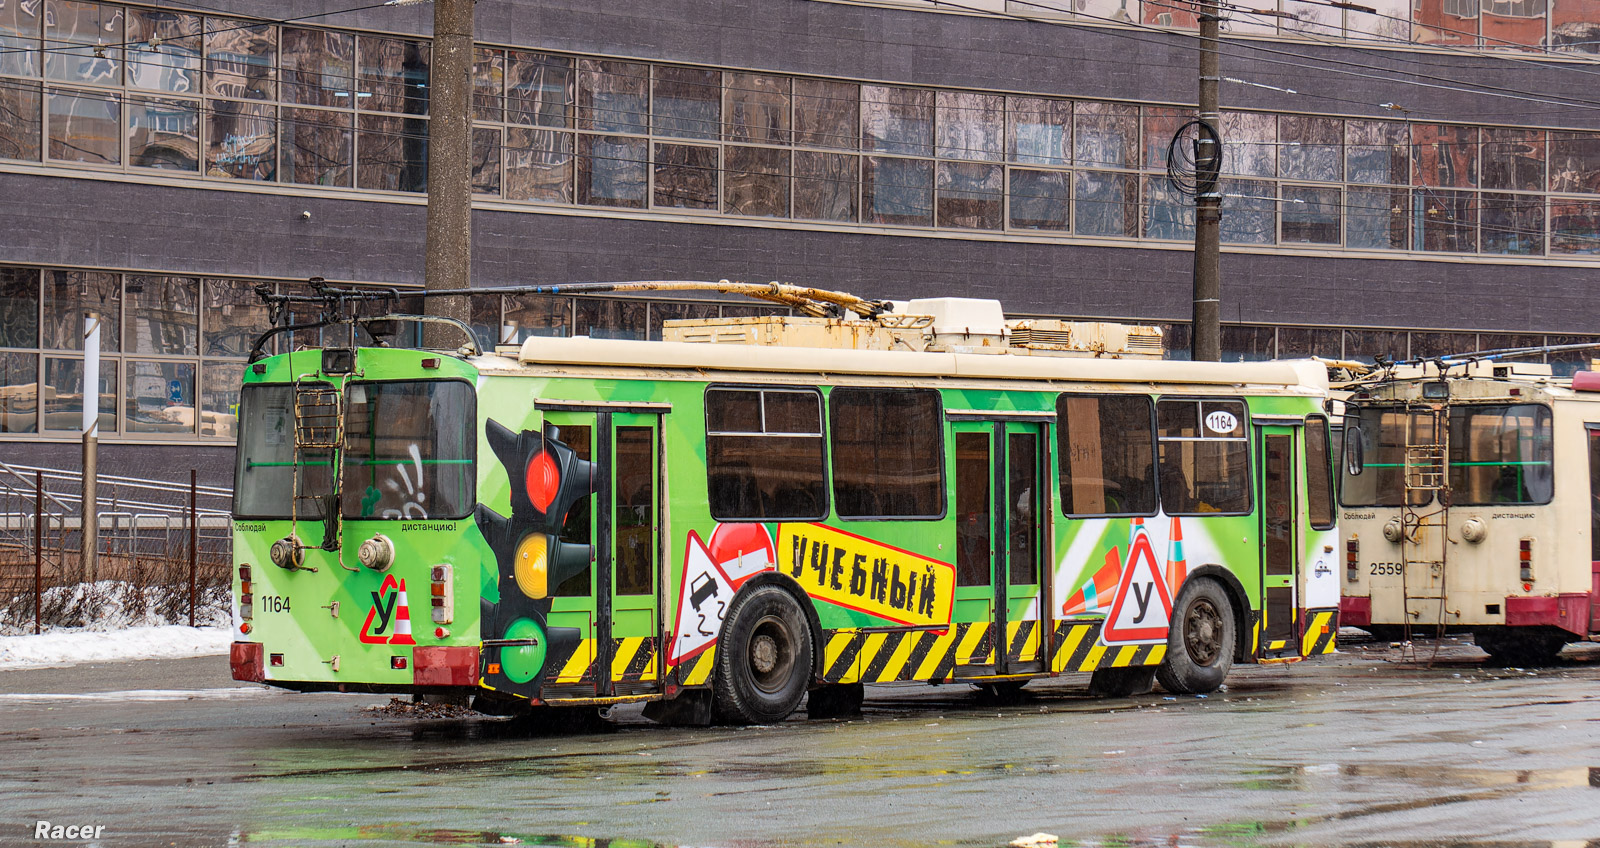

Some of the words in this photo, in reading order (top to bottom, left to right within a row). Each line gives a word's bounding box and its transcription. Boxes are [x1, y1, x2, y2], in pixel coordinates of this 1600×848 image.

[1210, 415, 1232, 429] 1164
[1344, 512, 1376, 520] Соблюдай
[235, 522, 266, 533] Соблюдай
[402, 522, 456, 532] дистанцию!
[1370, 562, 1403, 576] 2559
[791, 534, 937, 619] УЧЕБНЫЙ
[261, 595, 292, 613] 1164
